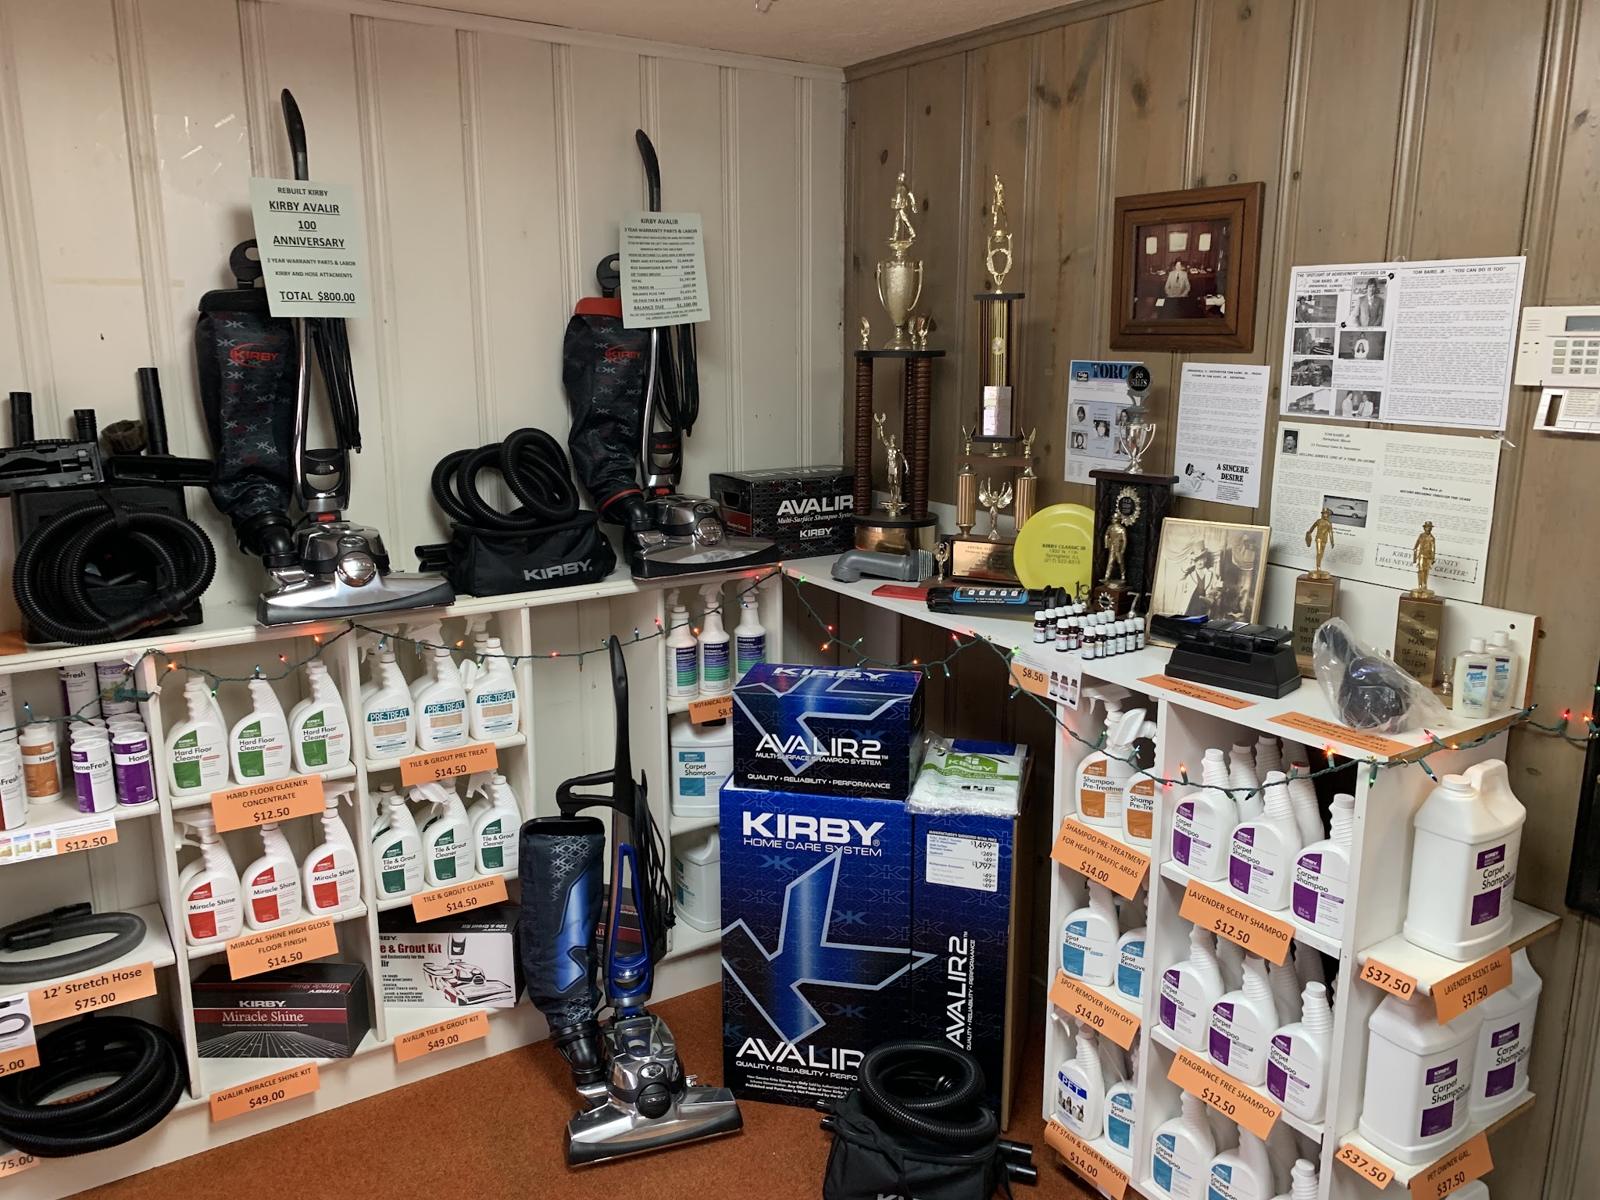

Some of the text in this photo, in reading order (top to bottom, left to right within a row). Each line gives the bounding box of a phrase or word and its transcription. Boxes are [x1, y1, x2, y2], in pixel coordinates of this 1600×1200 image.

[277, 186, 328, 198] REBUILT KIRBY
[268, 200, 340, 214] KIRBY AVALIR
[298, 220, 316, 230] 100
[273, 235, 345, 248] ANNIVERSARY
[280, 290, 356, 302] TOTAL $800.00
[232, 350, 278, 361] KIRBY
[1093, 364, 1129, 379] TORC
[1220, 472, 1244, 482] DESIRE
[1222, 464, 1249, 474] SINCERE
[776, 495, 853, 515] AVALIR
[800, 528, 832, 537] KIRBY
[1392, 551, 1412, 559] KIRBY
[524, 559, 590, 580] KIRBY
[772, 668, 890, 680] KIRBY
[1022, 667, 1044, 683] $8.50
[479, 691, 515, 703] PRE-TREAT
[430, 755, 453, 764] GROUT
[469, 748, 488, 757] TREAT
[756, 752, 810, 762] MULTI-SURFACE
[435, 764, 467, 778] $14.50
[784, 776, 827, 785] RELIABILITY
[832, 780, 890, 789] PERFORMANCE
[1083, 776, 1114, 785] Shampoo
[226, 780, 308, 800] HARD FLOOR CLAENER
[242, 792, 296, 808] CONCENTRATE
[1130, 795, 1153, 804] Shamp
[1130, 802, 1153, 810] Pre-Tre
[253, 808, 290, 822] $12.50
[743, 811, 885, 846] KIRBY
[65, 836, 108, 852] $12.50
[743, 838, 882, 856] HOME CARE SYSTEM
[1065, 823, 1146, 866] SHAMPOO PRE-TREATMENT
[1062, 835, 1138, 878] FOR HEAVY TRAFFIC AREAS
[314, 868, 355, 882] Miracle Shine
[1079, 861, 1109, 882] $14.00
[1296, 867, 1319, 882] Carpet
[1482, 864, 1505, 879] Carpet
[1296, 874, 1328, 893] Shampoo
[1482, 872, 1510, 889] Shampoo
[444, 888, 466, 899] GROUT
[467, 880, 494, 892] CLEANER
[446, 898, 477, 912] $14.50
[1188, 889, 1288, 941] LAVENDER SCENT SHAMPOO
[230, 920, 330, 950] MIRACAL SHINE HIGH GLOSS
[1066, 933, 1079, 942] Spot
[1214, 919, 1250, 944] $12.50
[258, 937, 307, 954] FLOOR FINISH
[389, 944, 442, 954] & Grout Kit
[1065, 939, 1091, 951] Remover
[267, 952, 303, 968] $14.50
[43, 968, 142, 1000] 12' Stretch Hose
[1365, 965, 1411, 995] $37.50
[1444, 960, 1503, 996] LAVENDER SCENT GAL.
[74, 993, 116, 1012] $75.00
[1060, 978, 1134, 1026] SPOT REMOVER WITH OXY
[1462, 985, 1488, 1008] $37.50
[222, 1011, 304, 1022] Miracle Shine
[1074, 1004, 1104, 1027] $14.00
[1213, 1014, 1232, 1029] Carpet
[402, 1032, 424, 1044] AVALIR
[426, 1028, 438, 1036] TILE
[446, 1020, 468, 1030] GROUT
[1212, 1020, 1239, 1041] Shampoo
[427, 1035, 459, 1051] $49.00
[736, 1037, 864, 1071] AVALIR
[736, 1061, 823, 1076] QUALITY RELIABILITY
[217, 1091, 244, 1102] AVALIR
[245, 1079, 276, 1093] MIRACLE
[278, 1072, 298, 1084] SHINE
[1178, 1055, 1275, 1118] FRAGRANCE FREE SHAMPOO
[1432, 1079, 1458, 1094] Carpet
[249, 1090, 285, 1108] $49.00
[1201, 1088, 1236, 1116] $12.50
[1431, 1085, 1465, 1105] Shampoo
[1050, 1122, 1060, 1133] PET
[1060, 1128, 1077, 1143] STAIN
[1082, 1144, 1098, 1160] ODER
[1098, 1156, 1127, 1182] REMOVER
[1, 1155, 34, 1170] 75.00
[1070, 1152, 1098, 1178] $14.00
[1342, 1149, 1387, 1183] $37.50
[1427, 1150, 1471, 1182] PET OWNER GAL.
[1436, 1171, 1466, 1196] $37.50
